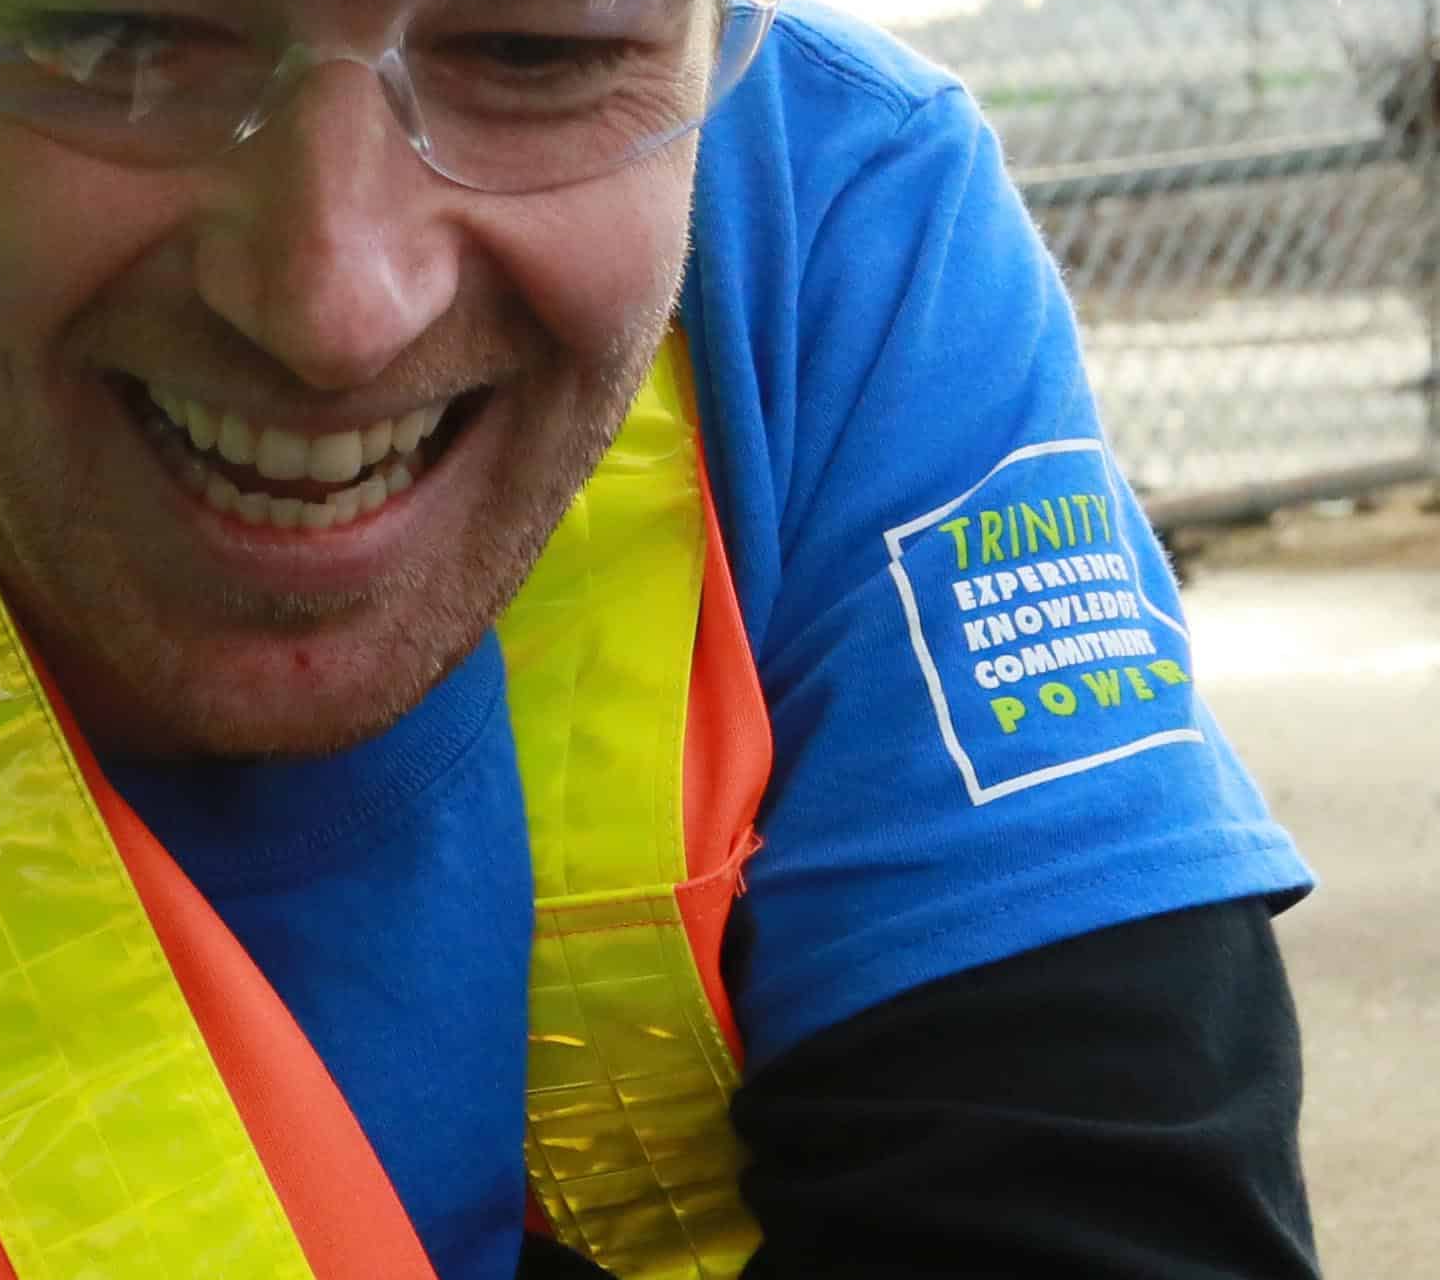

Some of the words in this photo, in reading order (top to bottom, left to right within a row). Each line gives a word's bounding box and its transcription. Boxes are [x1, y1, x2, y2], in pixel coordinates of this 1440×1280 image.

[938, 494, 1113, 571] TRINITY
[963, 590, 1140, 653] KNOWLEDGE
[989, 659, 1192, 735] POWER
